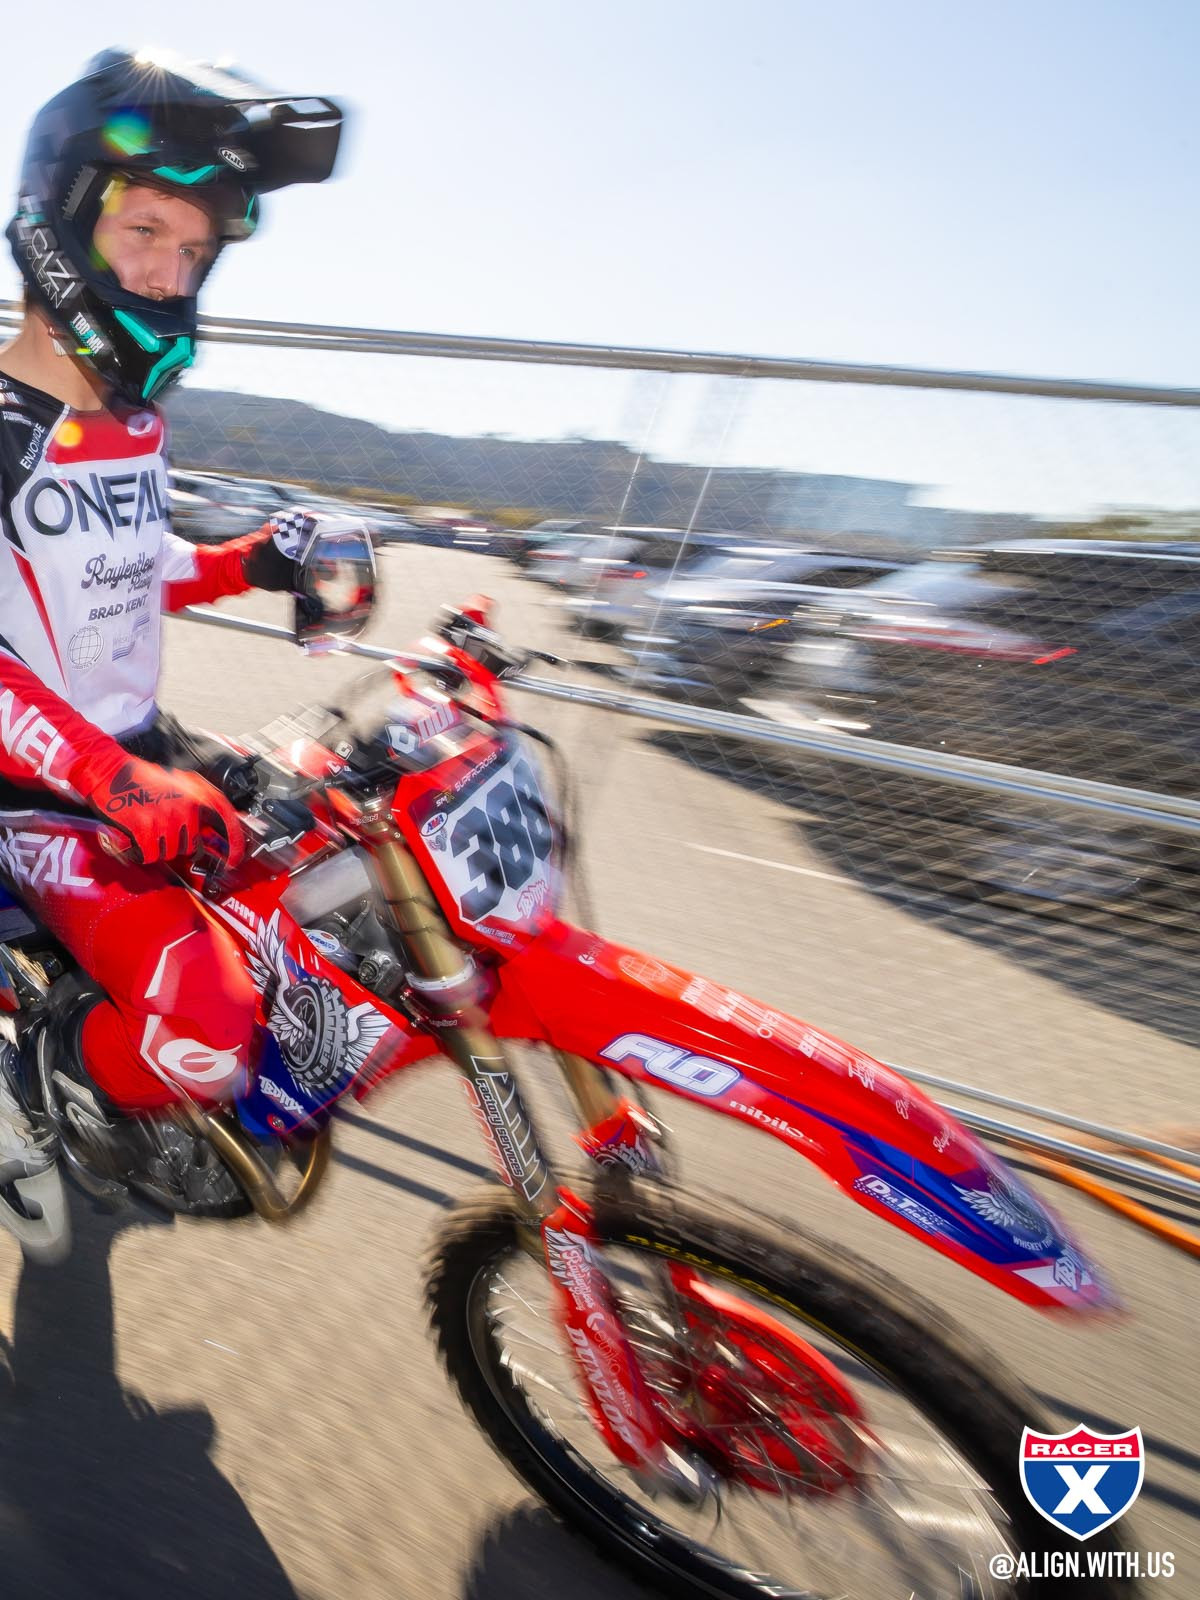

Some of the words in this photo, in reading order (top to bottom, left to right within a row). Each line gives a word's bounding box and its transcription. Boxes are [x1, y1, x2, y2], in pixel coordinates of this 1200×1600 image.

[88, 603, 124, 621] BRAD
[125, 594, 148, 613] KENT
[454, 751, 498, 792] SUPERCROSS
[425, 813, 445, 835] AMA
[450, 757, 553, 922] 388
[221, 896, 257, 927] AHM
[475, 1078, 504, 1126] Factory
[495, 1128, 524, 1177] services
[866, 1179, 899, 1204] Dirt
[897, 1198, 934, 1226] Tricks
[1013, 1235, 1043, 1251] WHISKEY
